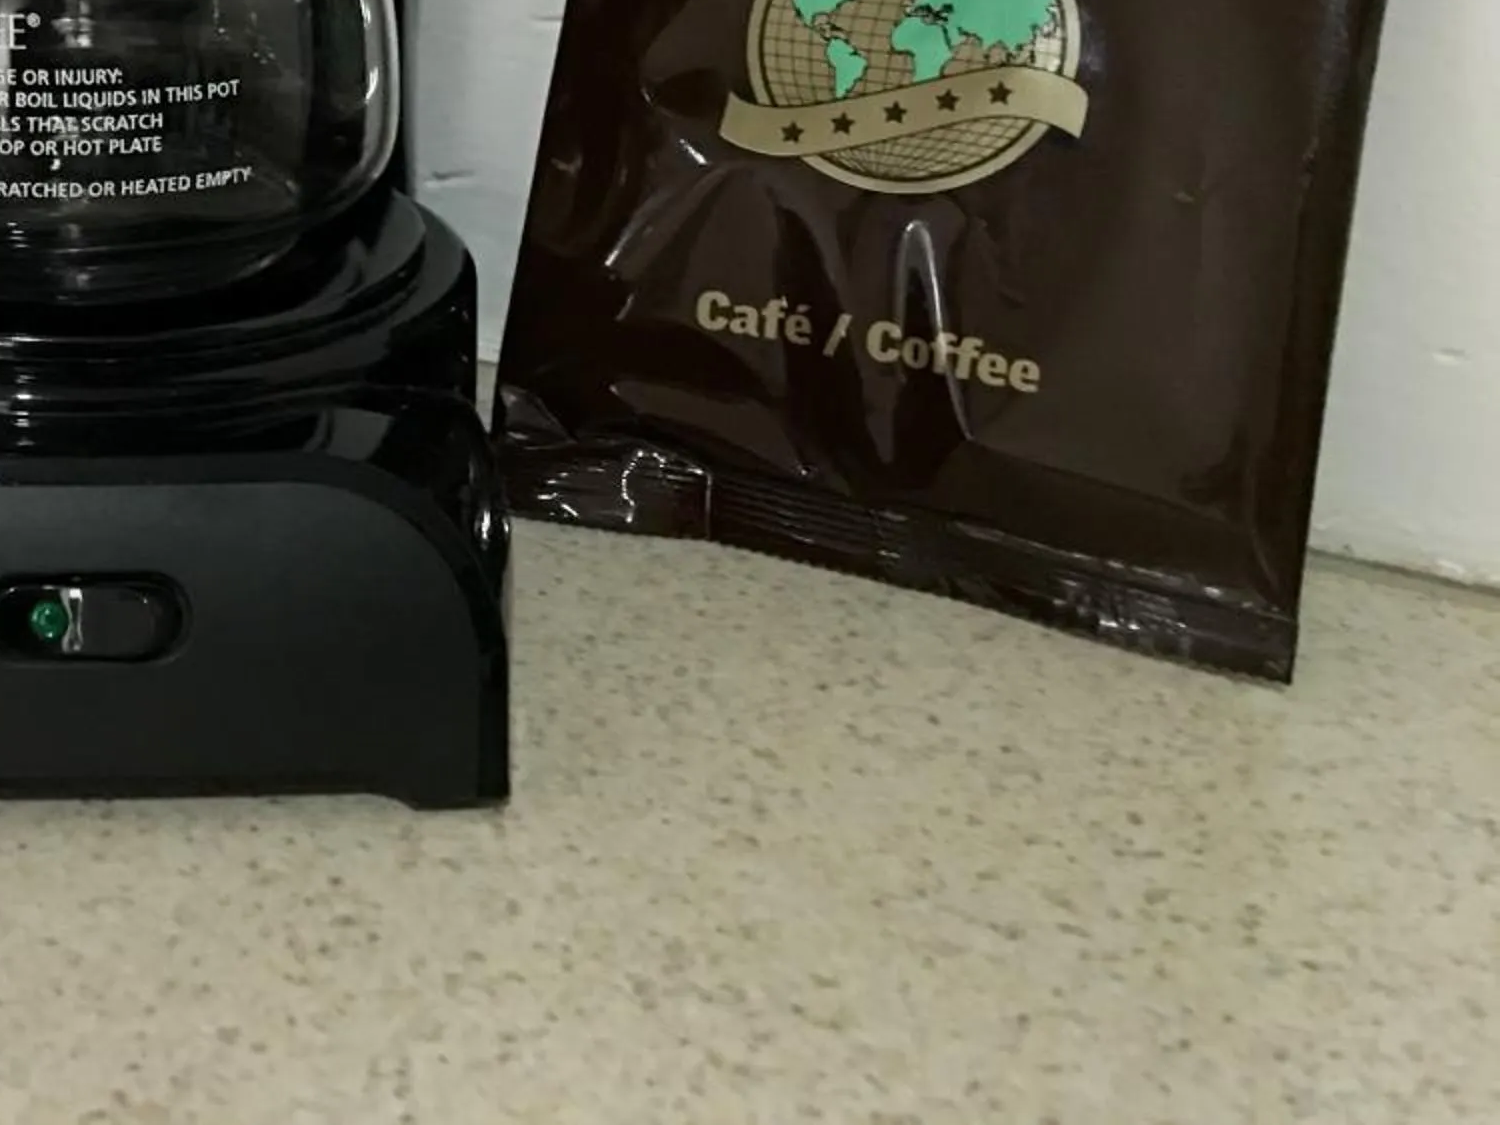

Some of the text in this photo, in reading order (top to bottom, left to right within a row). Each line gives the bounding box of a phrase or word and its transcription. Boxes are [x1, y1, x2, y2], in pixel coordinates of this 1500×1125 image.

[22, 69, 50, 86] OR
[55, 67, 124, 86] INJURY:
[15, 91, 59, 108] BOIL
[63, 89, 137, 110] LIQUIDS
[141, 87, 161, 105] IN
[165, 84, 204, 104] THIS
[207, 78, 241, 100] POT
[26, 115, 79, 134] THAT
[81, 112, 164, 133] SCRATCH
[29, 139, 59, 157] OR
[63, 138, 105, 157] HOT
[108, 135, 163, 155] PLATE
[88, 181, 116, 197] OR
[120, 175, 192, 197] HEATED
[195, 166, 253, 191] EMPTY
[695, 290, 813, 346] Café
[865, 320, 1041, 393] Coffee
